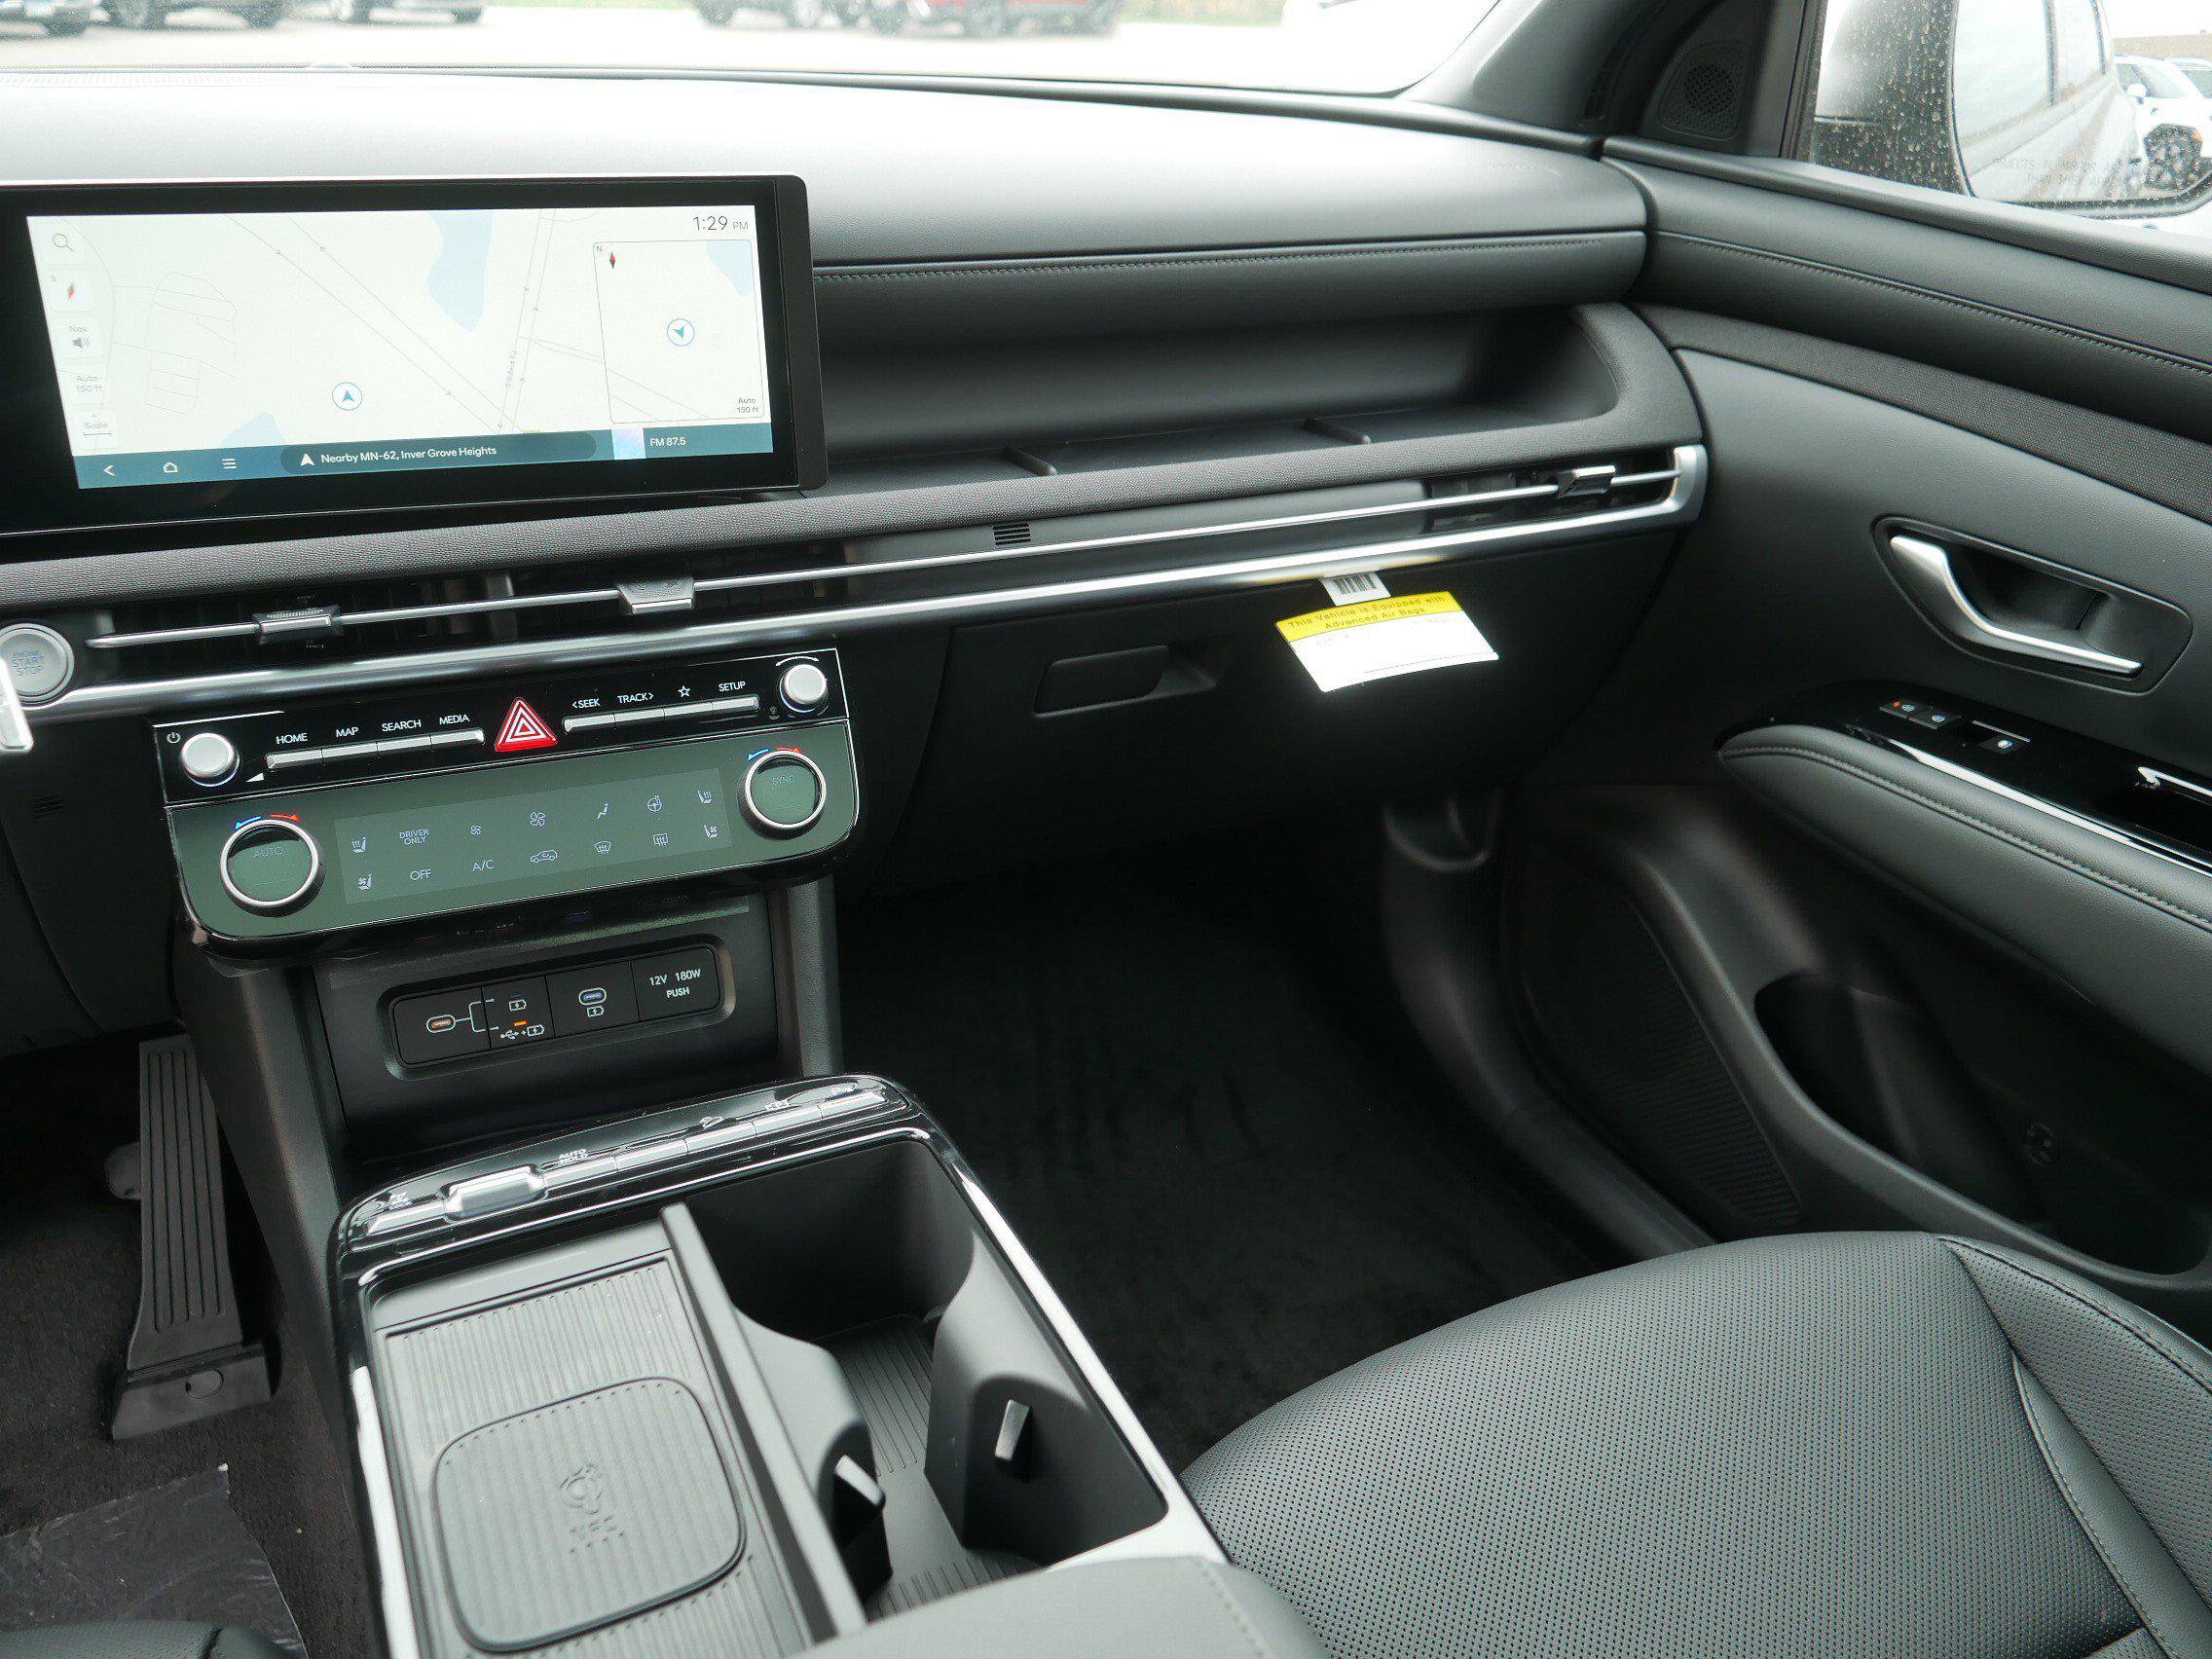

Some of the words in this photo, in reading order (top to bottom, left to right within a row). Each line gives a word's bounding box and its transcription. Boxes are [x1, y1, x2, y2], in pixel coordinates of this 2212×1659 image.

[692, 215, 728, 231] 1:29
[733, 221, 749, 231] PM
[76, 385, 92, 393] 150
[649, 437, 666, 447] FM
[667, 436, 686, 447] 87.5
[320, 454, 358, 464] Nearby
[359, 451, 400, 462] MN-62,
[401, 450, 426, 460] Inver
[427, 448, 458, 459] Grove
[458, 446, 497, 459] Heights
[1287, 618, 1313, 628] This
[1314, 608, 1355, 621] Vehicle
[1373, 598, 1420, 612] Equipped
[1423, 596, 1446, 606] with
[1324, 613, 1378, 629] Advanced
[1382, 611, 1398, 620] Air
[1399, 608, 1426, 619] Bags
[719, 682, 746, 692] SETUP
[382, 719, 422, 732] SEARCH
[439, 714, 470, 725] MEDIA
[276, 732, 309, 745] HOME
[335, 726, 359, 738] MAP
[772, 774, 795, 786] SYNC
[399, 828, 429, 839] DRIVER
[404, 836, 427, 845] ONLY
[252, 845, 284, 859] AUTO
[472, 859, 496, 871] A/C
[409, 868, 432, 881] OFF
[649, 974, 668, 986] 12V
[675, 968, 701, 982] 180W
[666, 986, 690, 999] PUSH
